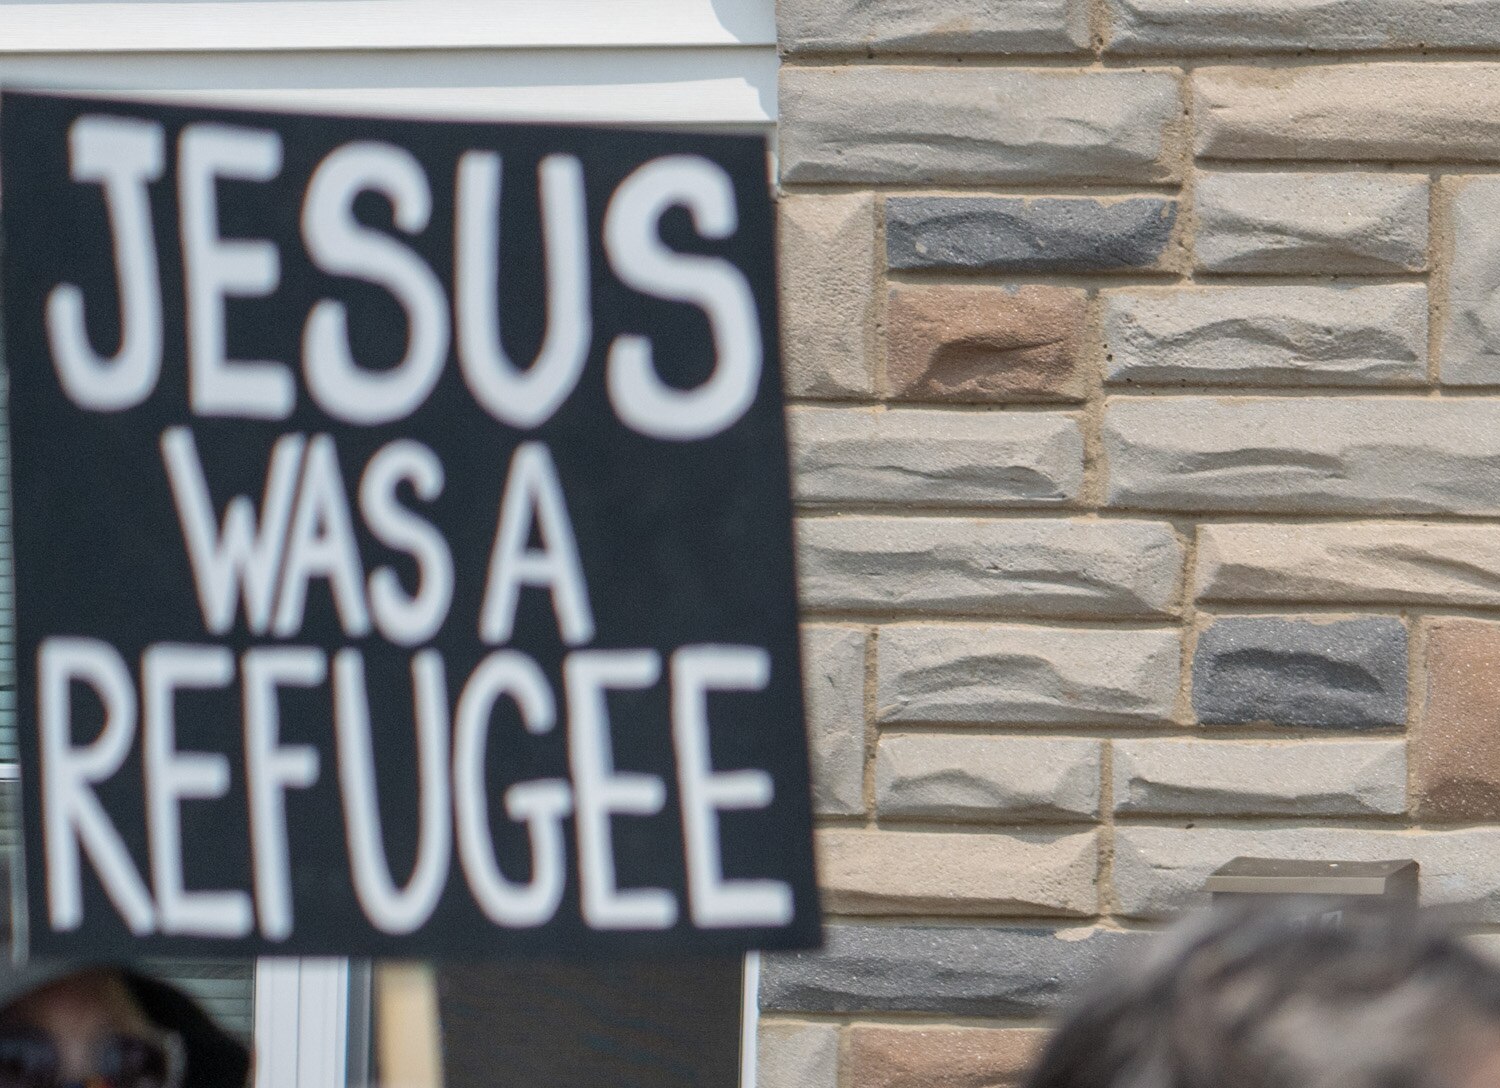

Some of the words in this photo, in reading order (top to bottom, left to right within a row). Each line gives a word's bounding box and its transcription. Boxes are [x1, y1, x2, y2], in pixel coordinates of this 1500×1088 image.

[46, 114, 765, 441] JESUS
[160, 425, 456, 647] WAS
[479, 441, 596, 647] A
[37, 635, 796, 942] REFUGEE
